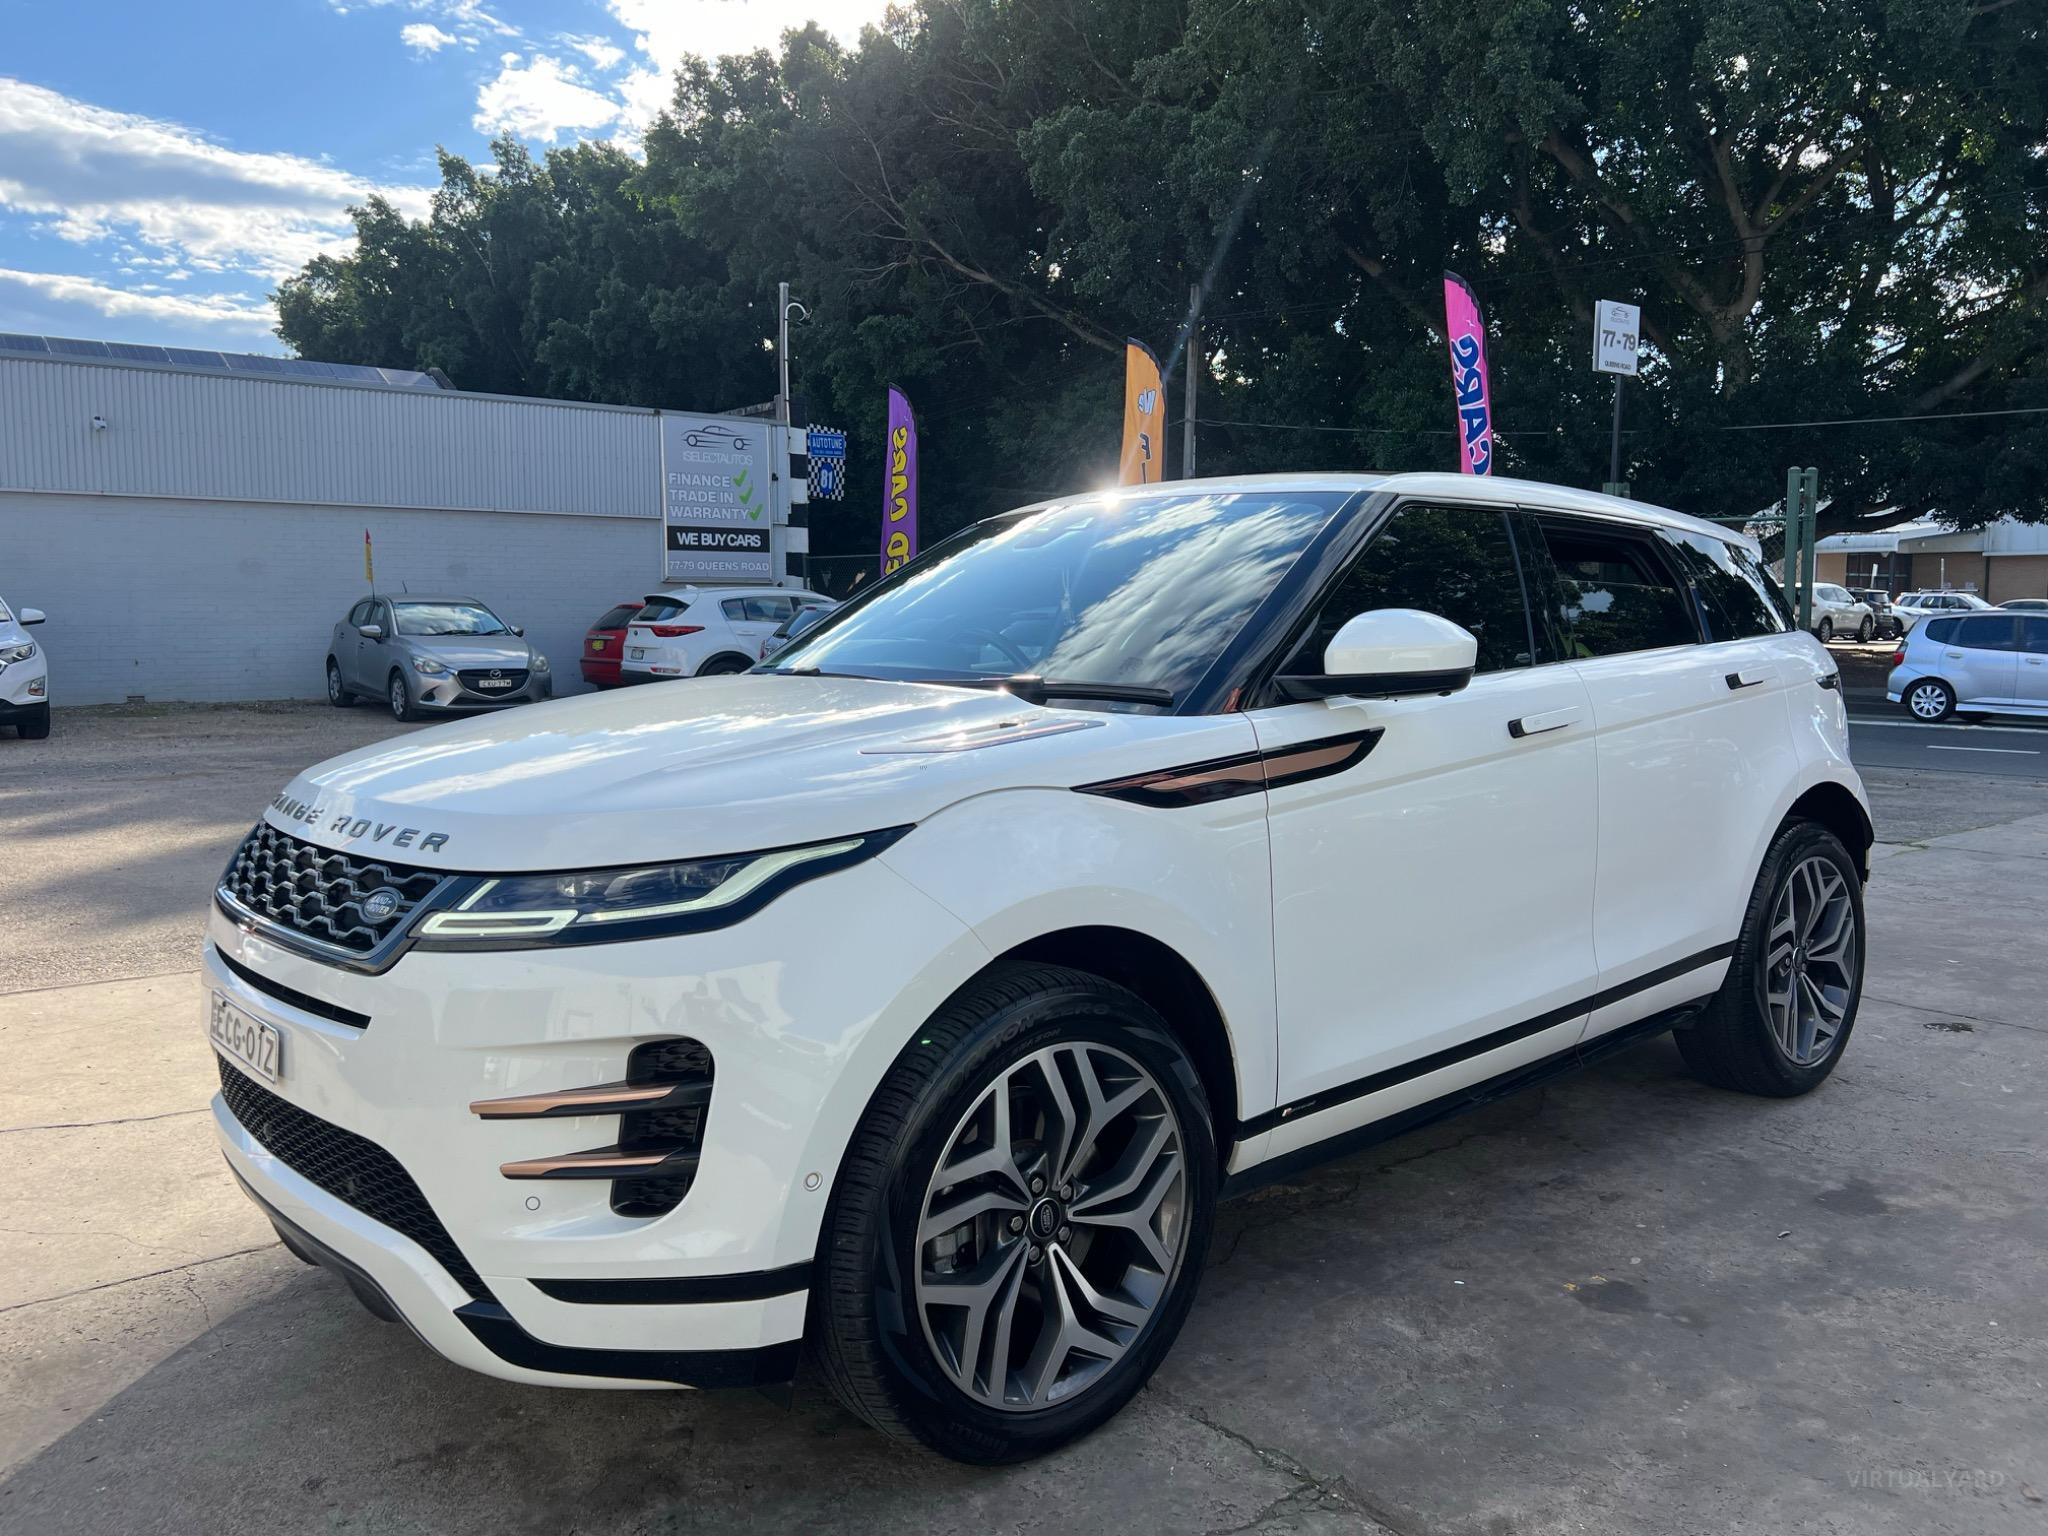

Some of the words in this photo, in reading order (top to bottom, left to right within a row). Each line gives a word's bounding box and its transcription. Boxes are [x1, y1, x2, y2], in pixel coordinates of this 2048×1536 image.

[812, 436, 843, 449] AUTOTUNE
[668, 472, 731, 488] FINANCE
[820, 470, 833, 490] 81
[669, 489, 718, 503] TRADE
[720, 491, 734, 504] IN
[669, 506, 749, 520] WARRANTY
[677, 532, 698, 545] WE
[701, 533, 726, 546] BUY
[727, 534, 761, 547] CARS
[697, 561, 739, 571] QUEENS
[741, 562, 769, 572] ROAD
[330, 815, 450, 853] ROVER
